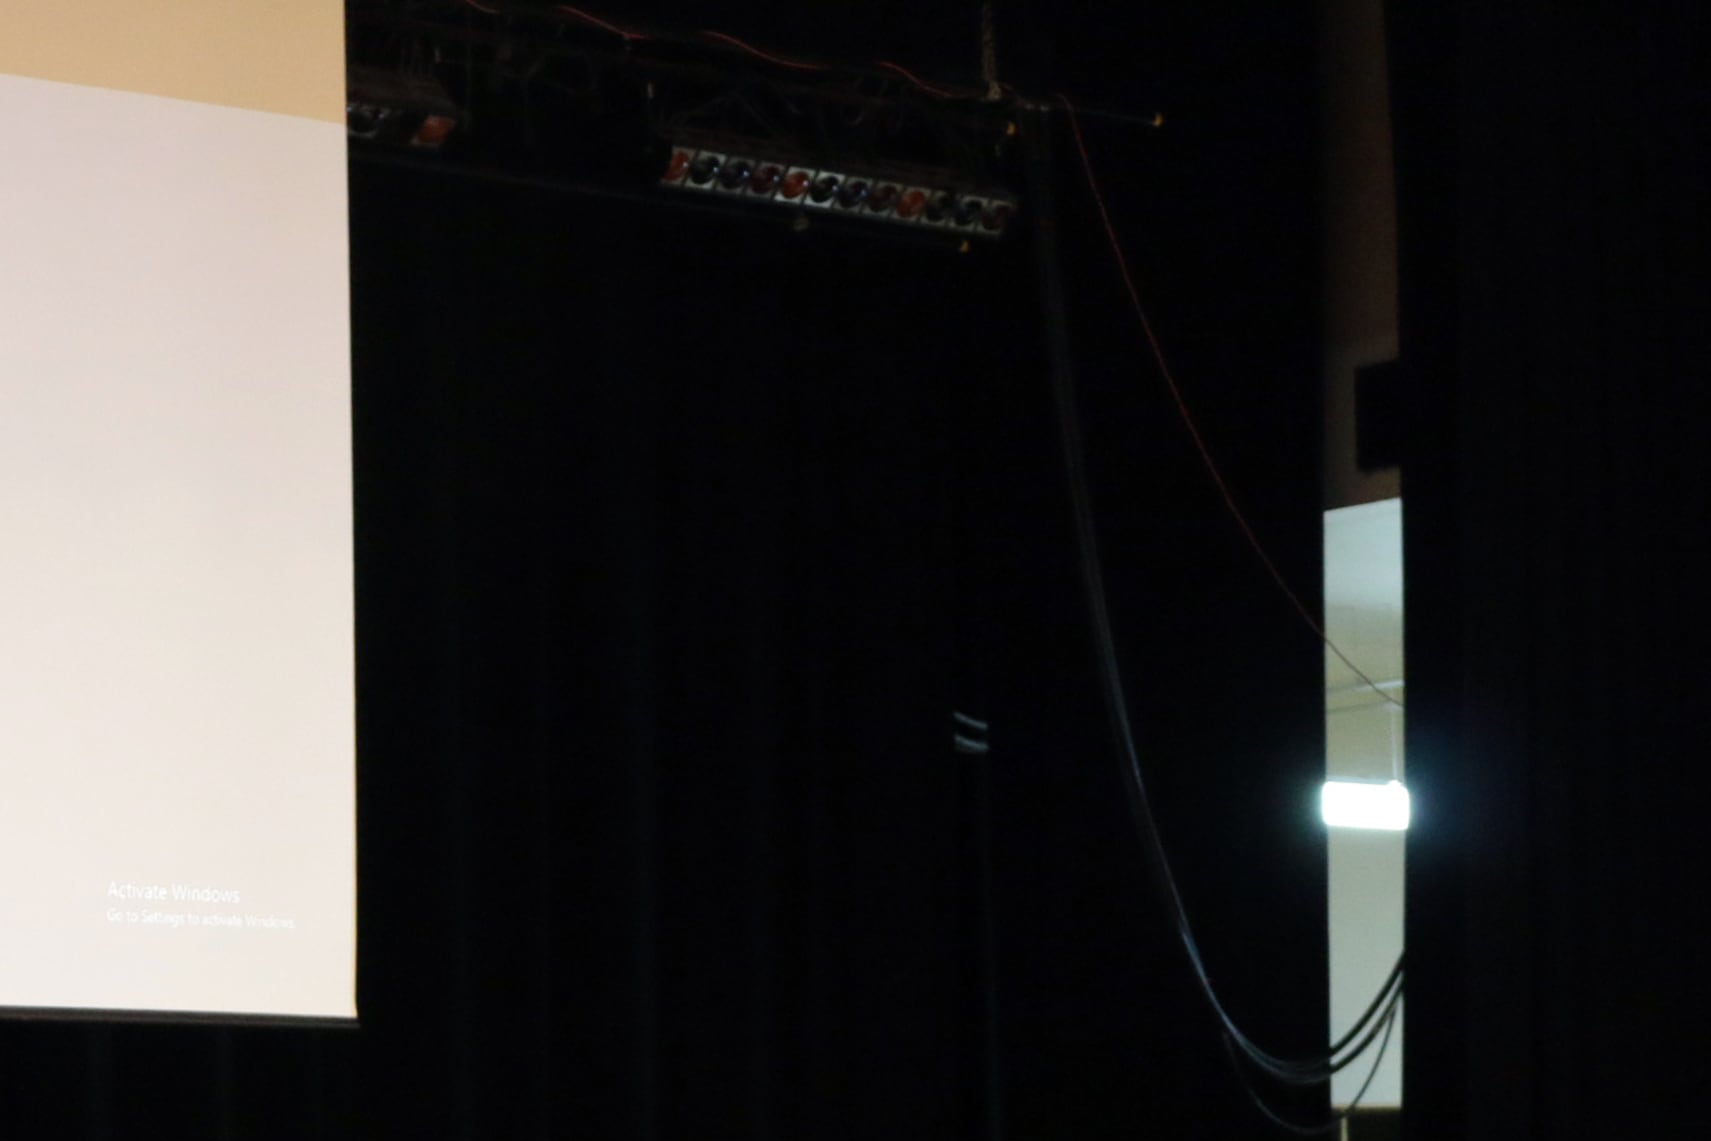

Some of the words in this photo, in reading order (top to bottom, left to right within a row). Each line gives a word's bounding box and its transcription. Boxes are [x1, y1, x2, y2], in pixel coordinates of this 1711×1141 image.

[107, 881, 167, 901] Activate
[171, 884, 241, 904] Windows
[141, 909, 185, 928] Settings
